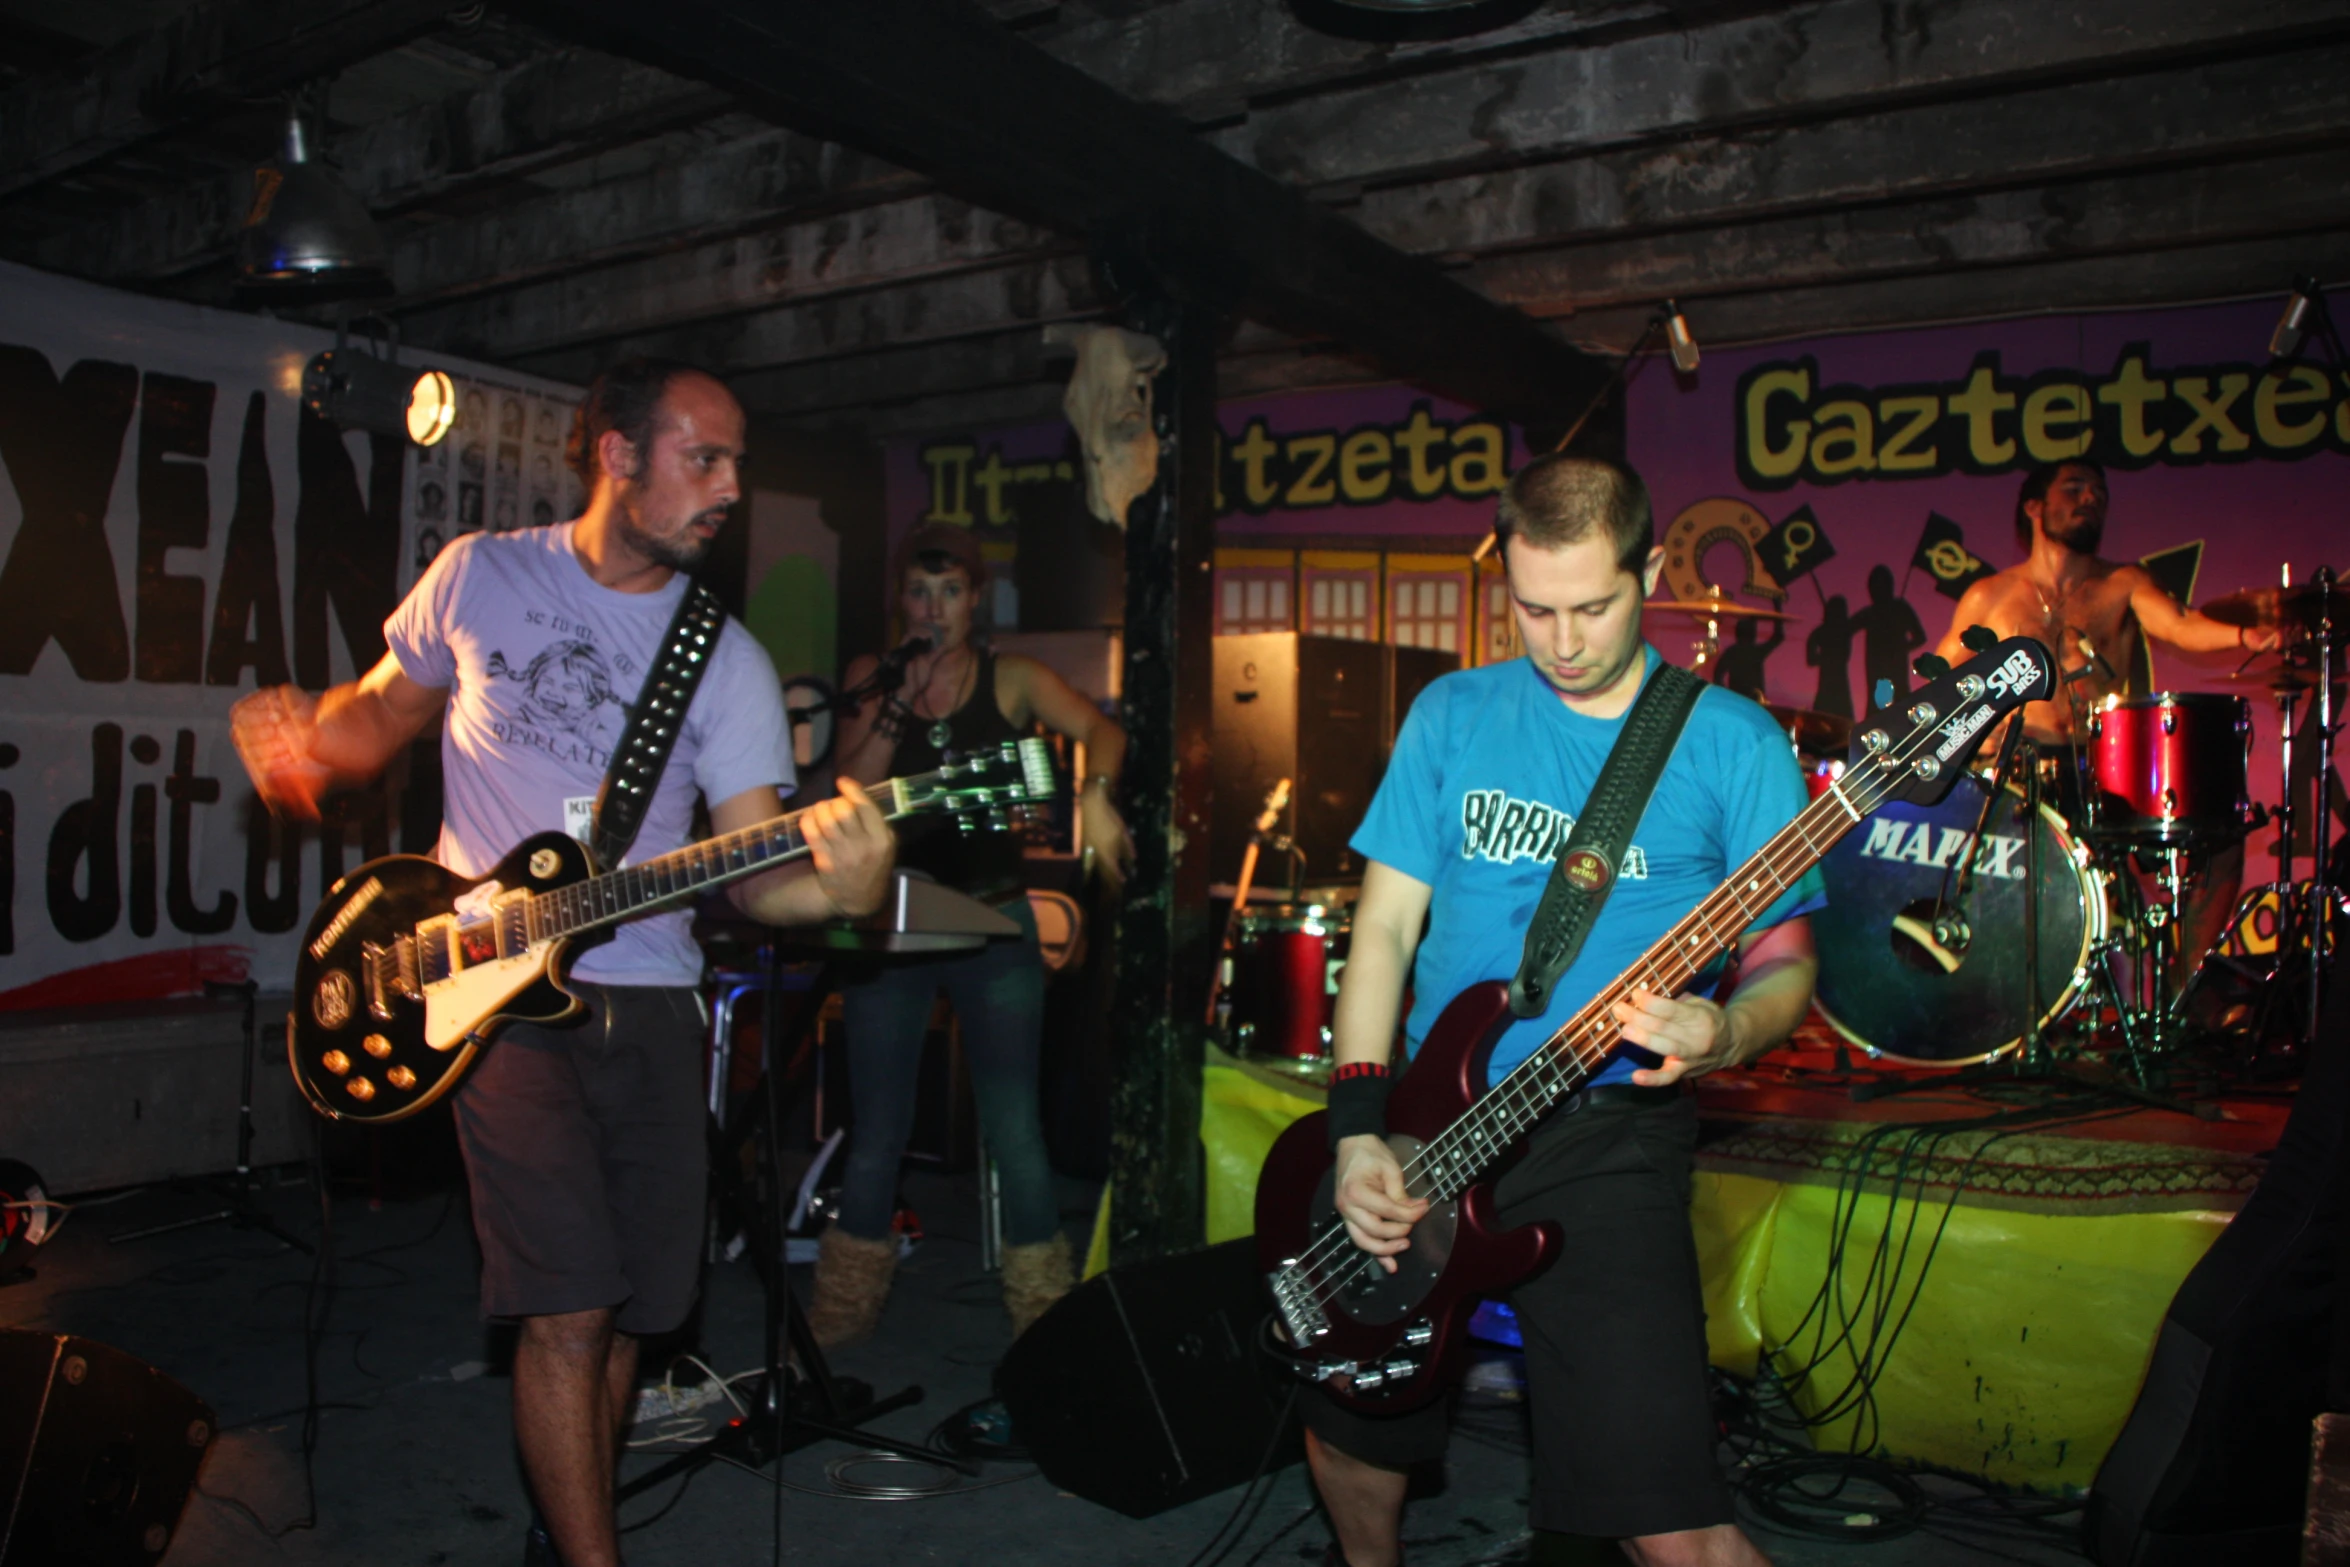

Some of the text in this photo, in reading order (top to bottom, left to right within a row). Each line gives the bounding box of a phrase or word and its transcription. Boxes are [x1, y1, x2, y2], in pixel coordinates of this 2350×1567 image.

[1745, 355, 2350, 479] Gaztetxe
[1986, 649, 2032, 699] SUB
[1936, 705, 1994, 760] MUSIC MAN
